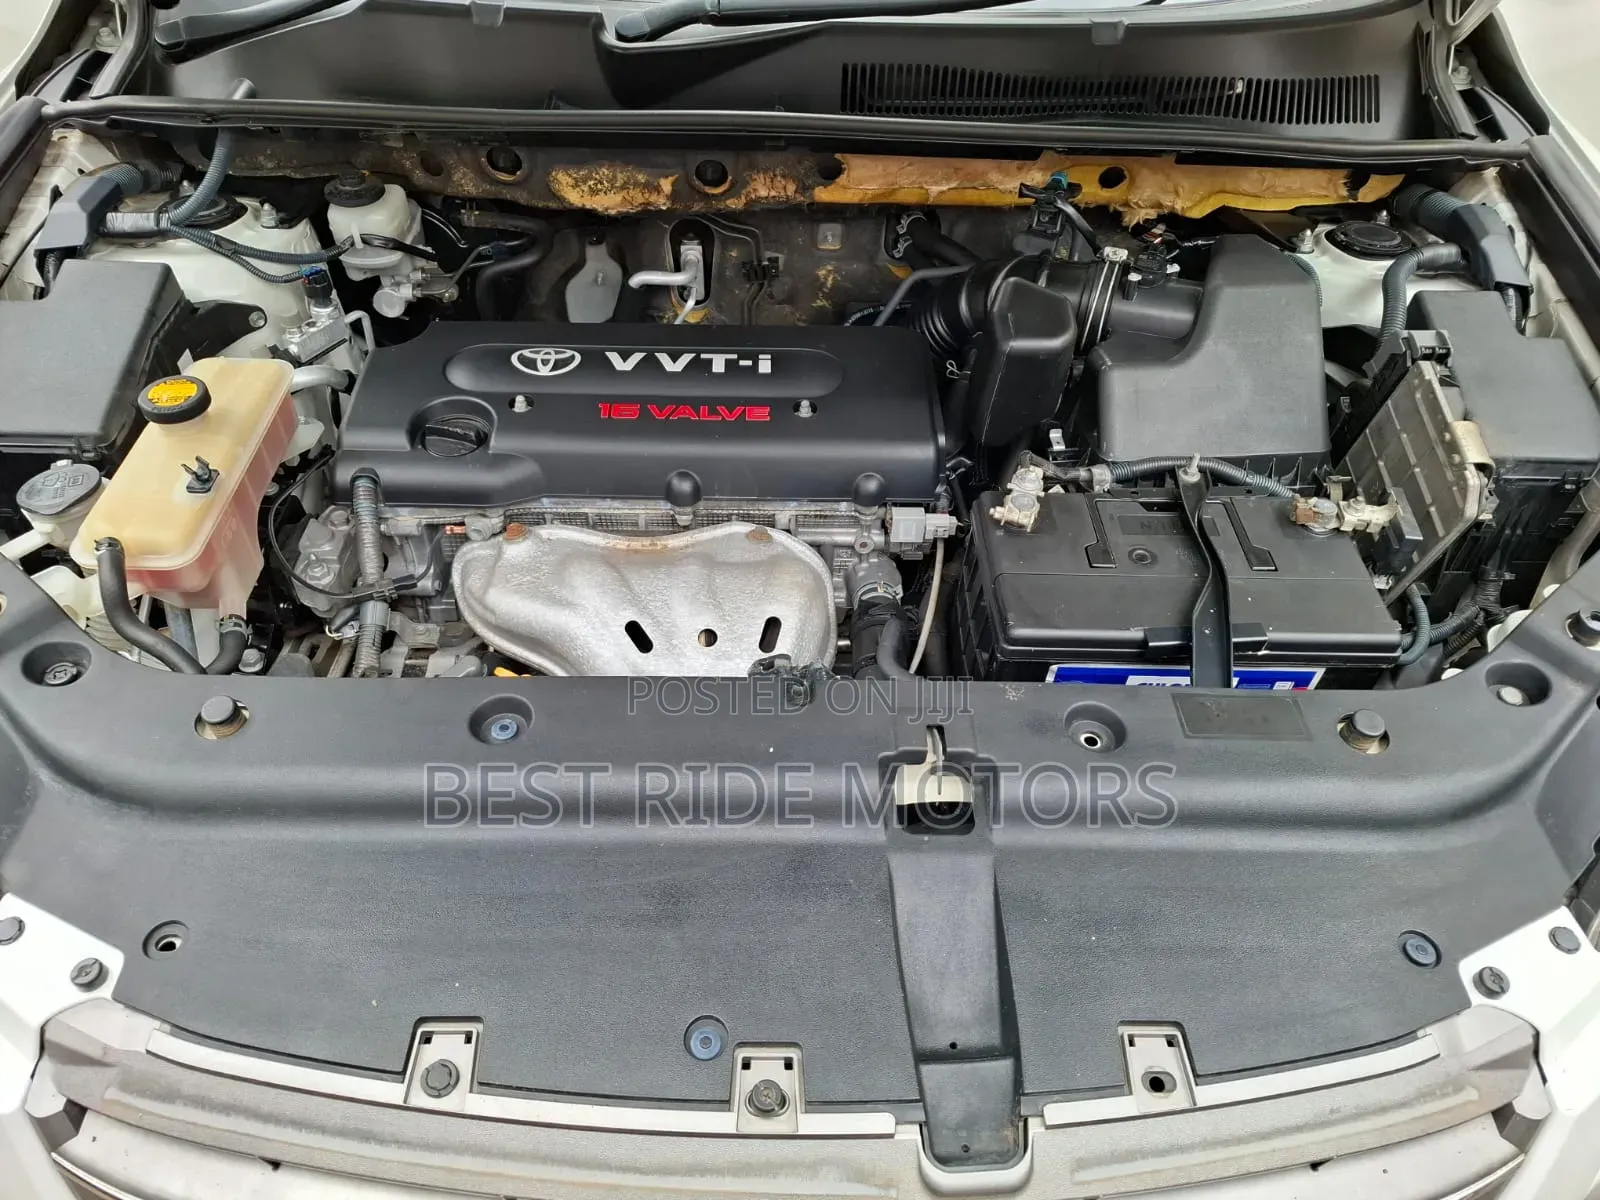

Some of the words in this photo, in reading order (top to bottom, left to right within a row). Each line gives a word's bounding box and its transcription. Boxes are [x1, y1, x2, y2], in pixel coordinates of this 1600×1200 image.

[605, 351, 772, 374] VVT-i
[599, 403, 641, 419] 16
[647, 404, 771, 422] VALVE
